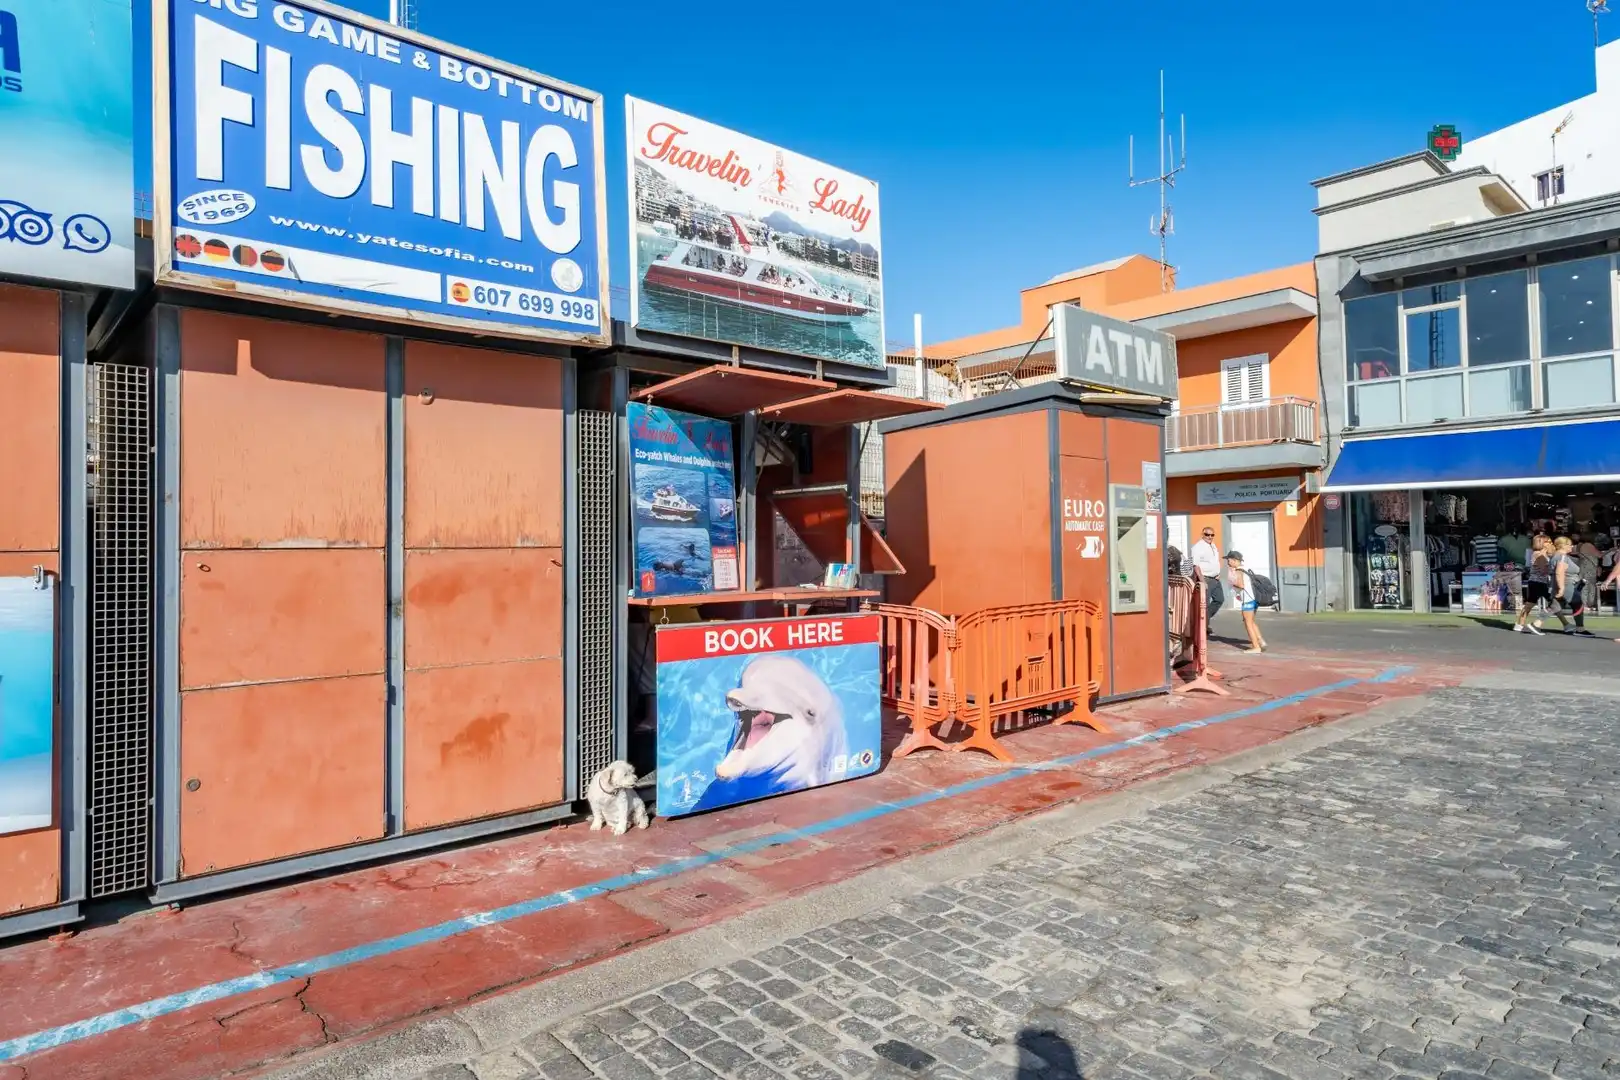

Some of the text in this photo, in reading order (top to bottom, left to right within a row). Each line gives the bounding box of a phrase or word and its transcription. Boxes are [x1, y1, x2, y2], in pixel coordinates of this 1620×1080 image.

[273, 4, 588, 122] GAME & BOTTOM
[195, 14, 582, 254] FISHING
[183, 194, 246, 211] SINCE
[188, 203, 249, 221] 1969
[809, 178, 871, 232] Lady
[269, 215, 534, 273] www.yatesofia.com
[474, 285, 594, 321] 607 699 998
[1085, 324, 1164, 386] ATM
[1064, 499, 1105, 517] EURO
[705, 621, 844, 653] BOOK HERE
